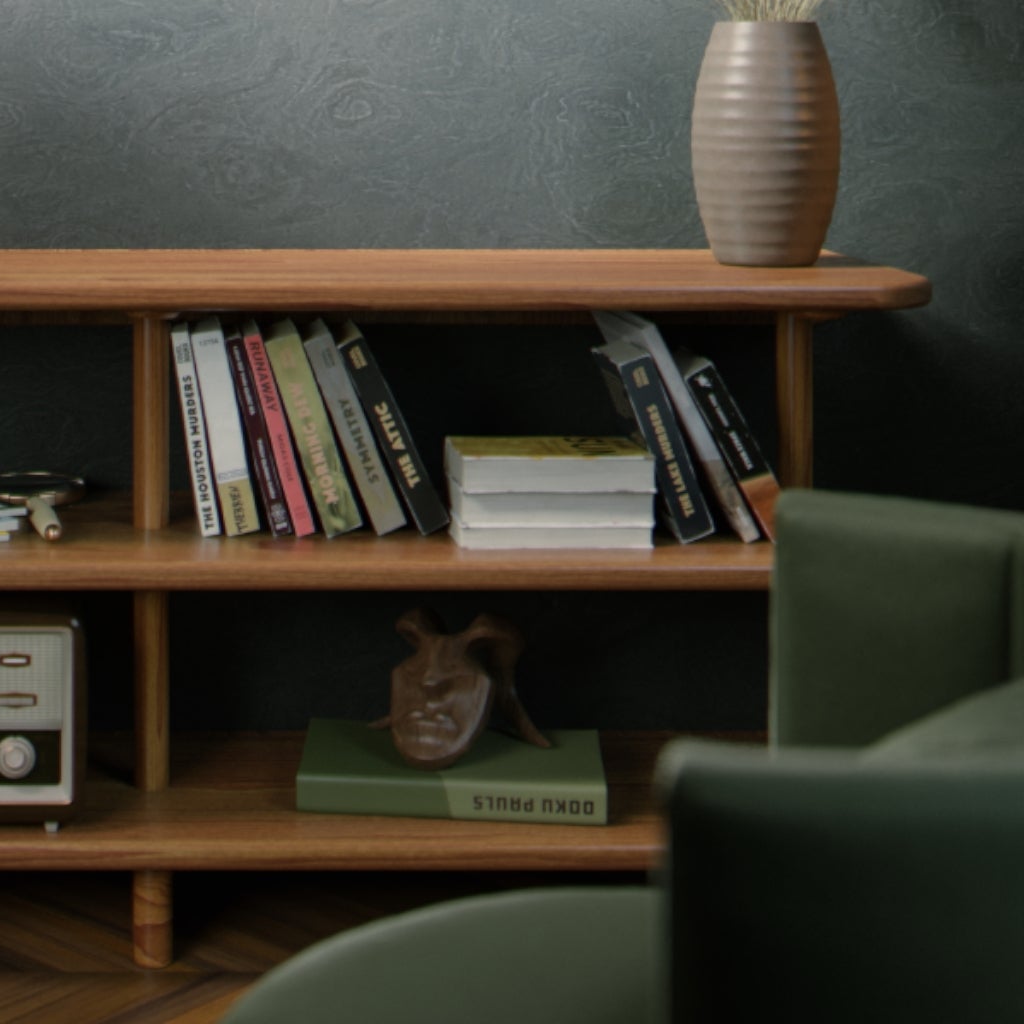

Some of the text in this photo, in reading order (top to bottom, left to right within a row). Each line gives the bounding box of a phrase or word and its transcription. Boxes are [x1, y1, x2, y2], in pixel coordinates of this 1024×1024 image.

[249, 341, 279, 412] RUNAWAY
[182, 375, 215, 530] THE HOUSTON MURDERS
[301, 422, 340, 505] MORNING
[338, 398, 380, 484] SYMMETRY
[374, 401, 421, 489] THE ATTIC
[645, 403, 675, 461] MURDERS
[678, 492, 696, 519] THE
[473, 794, 595, 815] DOKU PAULS
